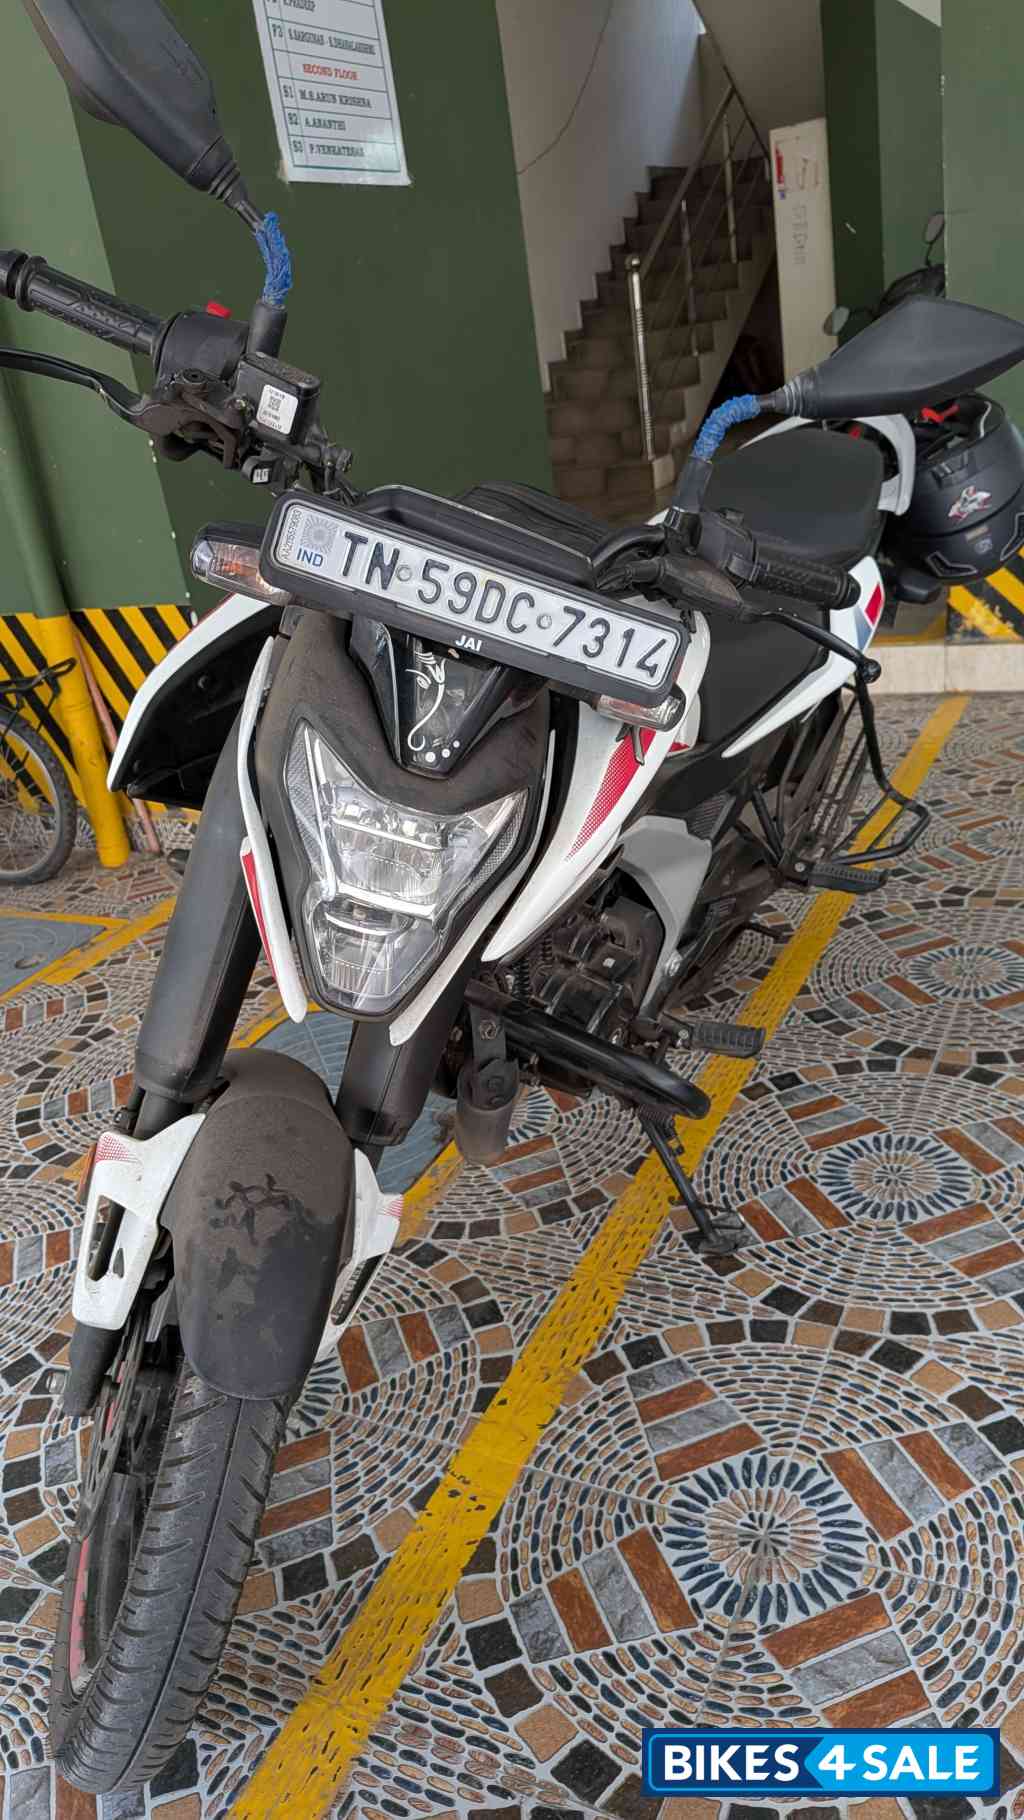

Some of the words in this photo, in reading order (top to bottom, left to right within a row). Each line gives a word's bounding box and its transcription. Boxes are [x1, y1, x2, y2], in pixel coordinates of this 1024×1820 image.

[303, 63, 334, 78] SECOND
[334, 68, 359, 81] FLOOR
[283, 85, 295, 99] S1
[296, 547, 324, 567] IND
[340, 531, 400, 590] TN
[417, 559, 536, 634] 59DC
[552, 606, 669, 679] 7314
[455, 635, 483, 652] JAI
